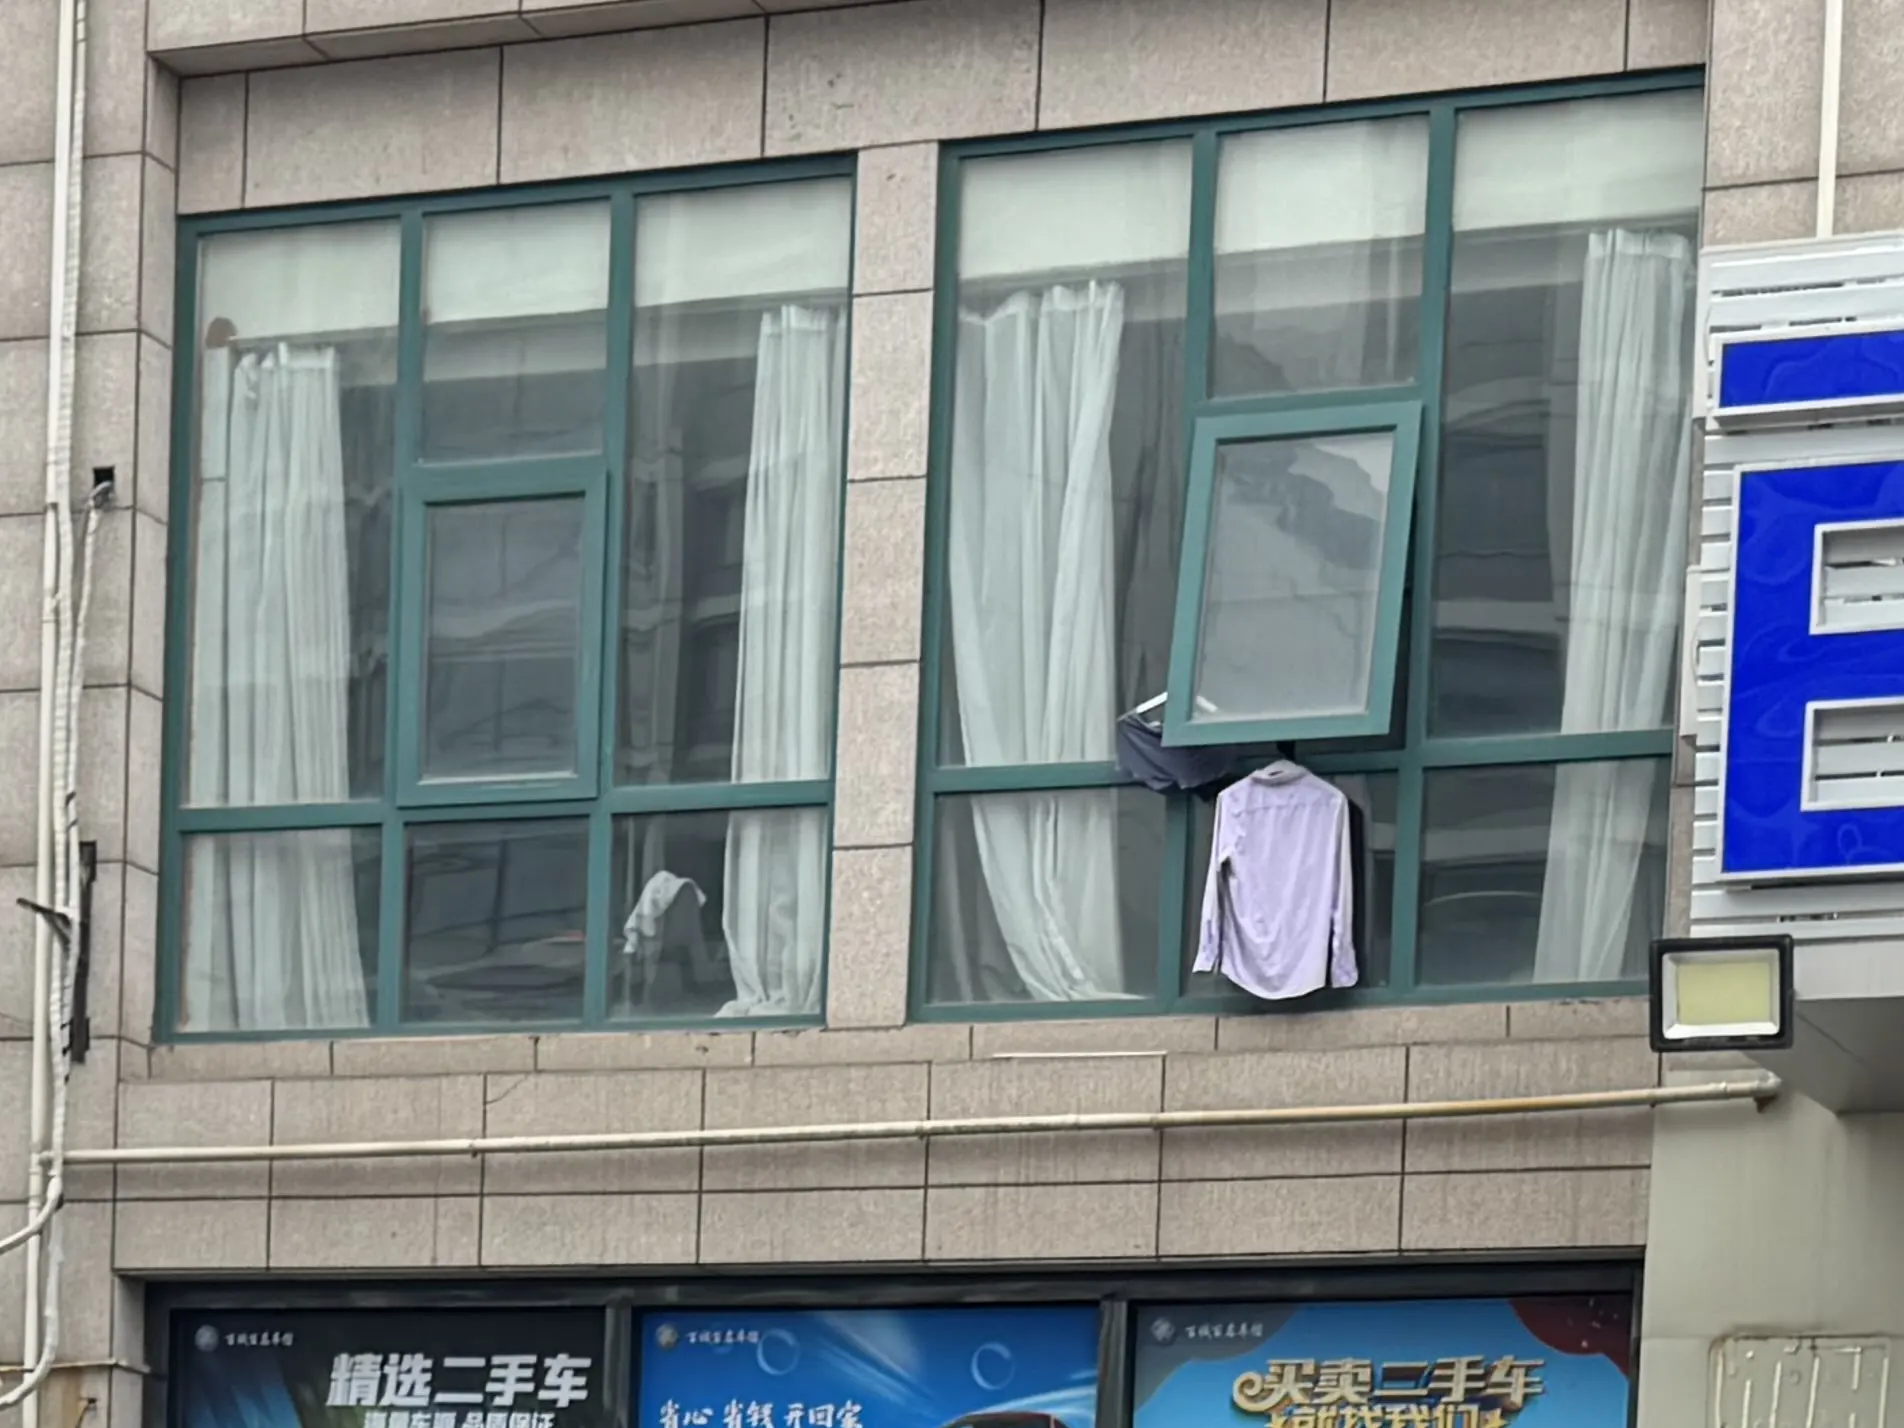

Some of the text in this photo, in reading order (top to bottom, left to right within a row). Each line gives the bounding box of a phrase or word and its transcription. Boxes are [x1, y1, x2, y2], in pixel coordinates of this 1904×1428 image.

[326, 1351, 593, 1409] 精选二手车
[1233, 1355, 1546, 1411] 买卖二手车
